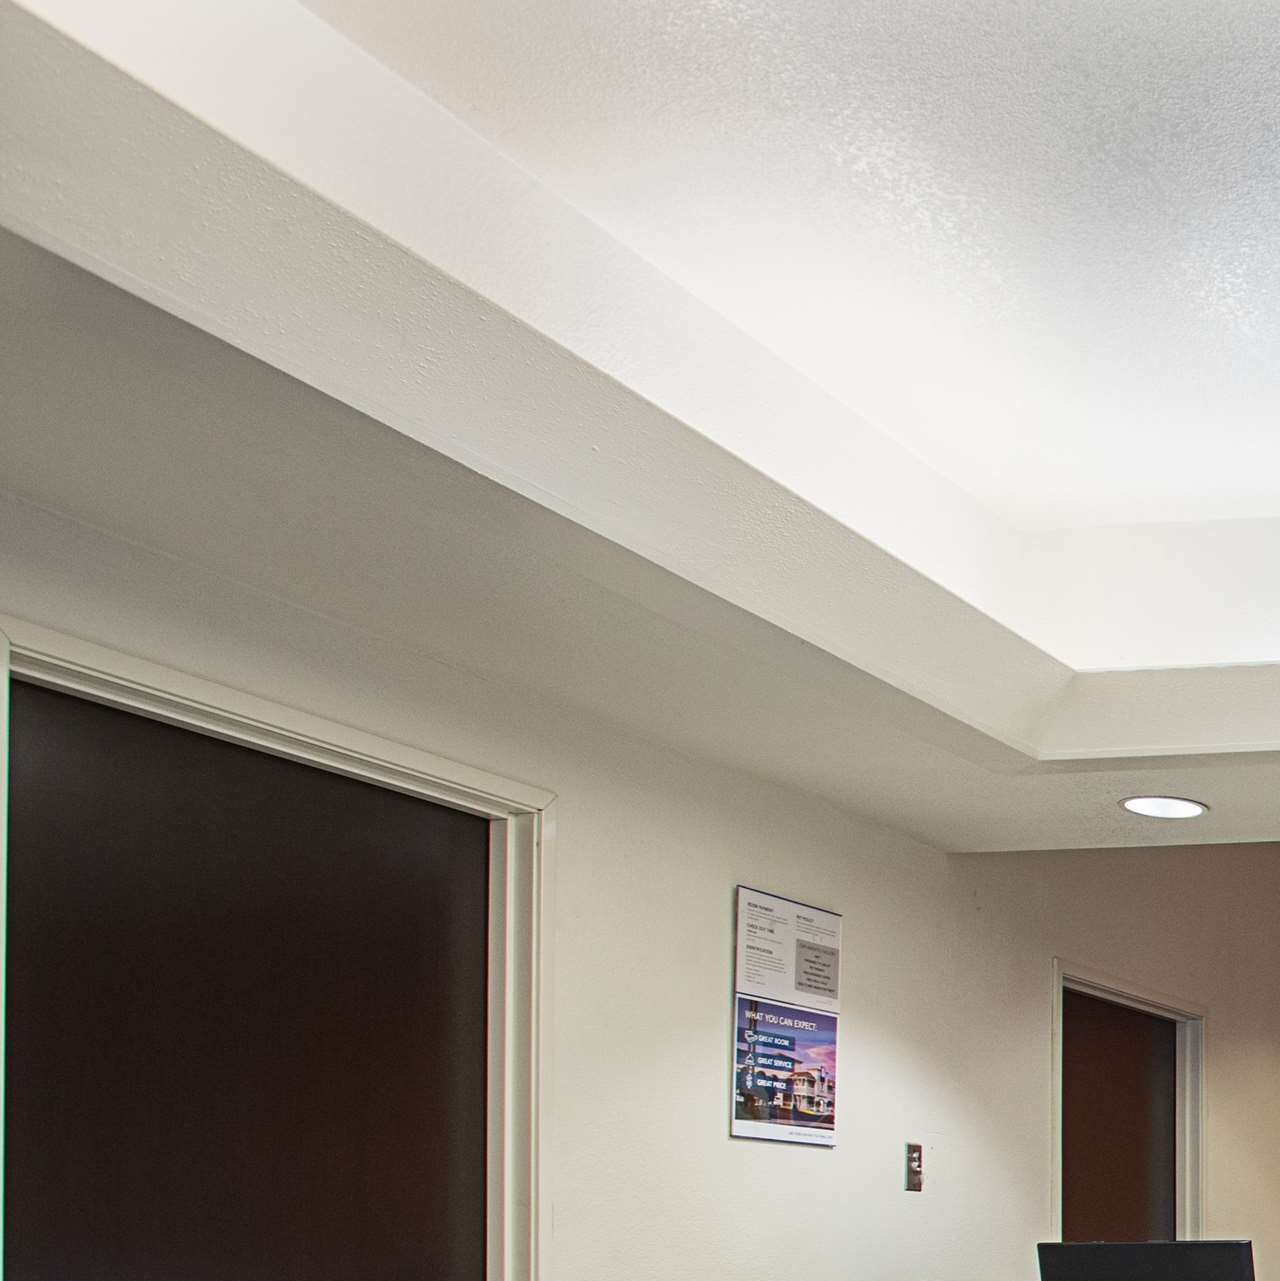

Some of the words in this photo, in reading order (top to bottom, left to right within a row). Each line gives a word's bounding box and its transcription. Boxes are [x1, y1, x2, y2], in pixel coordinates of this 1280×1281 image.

[745, 1010, 763, 1021] WHAT
[765, 1013, 779, 1024] YOU
[780, 1016, 793, 1027] CAN
